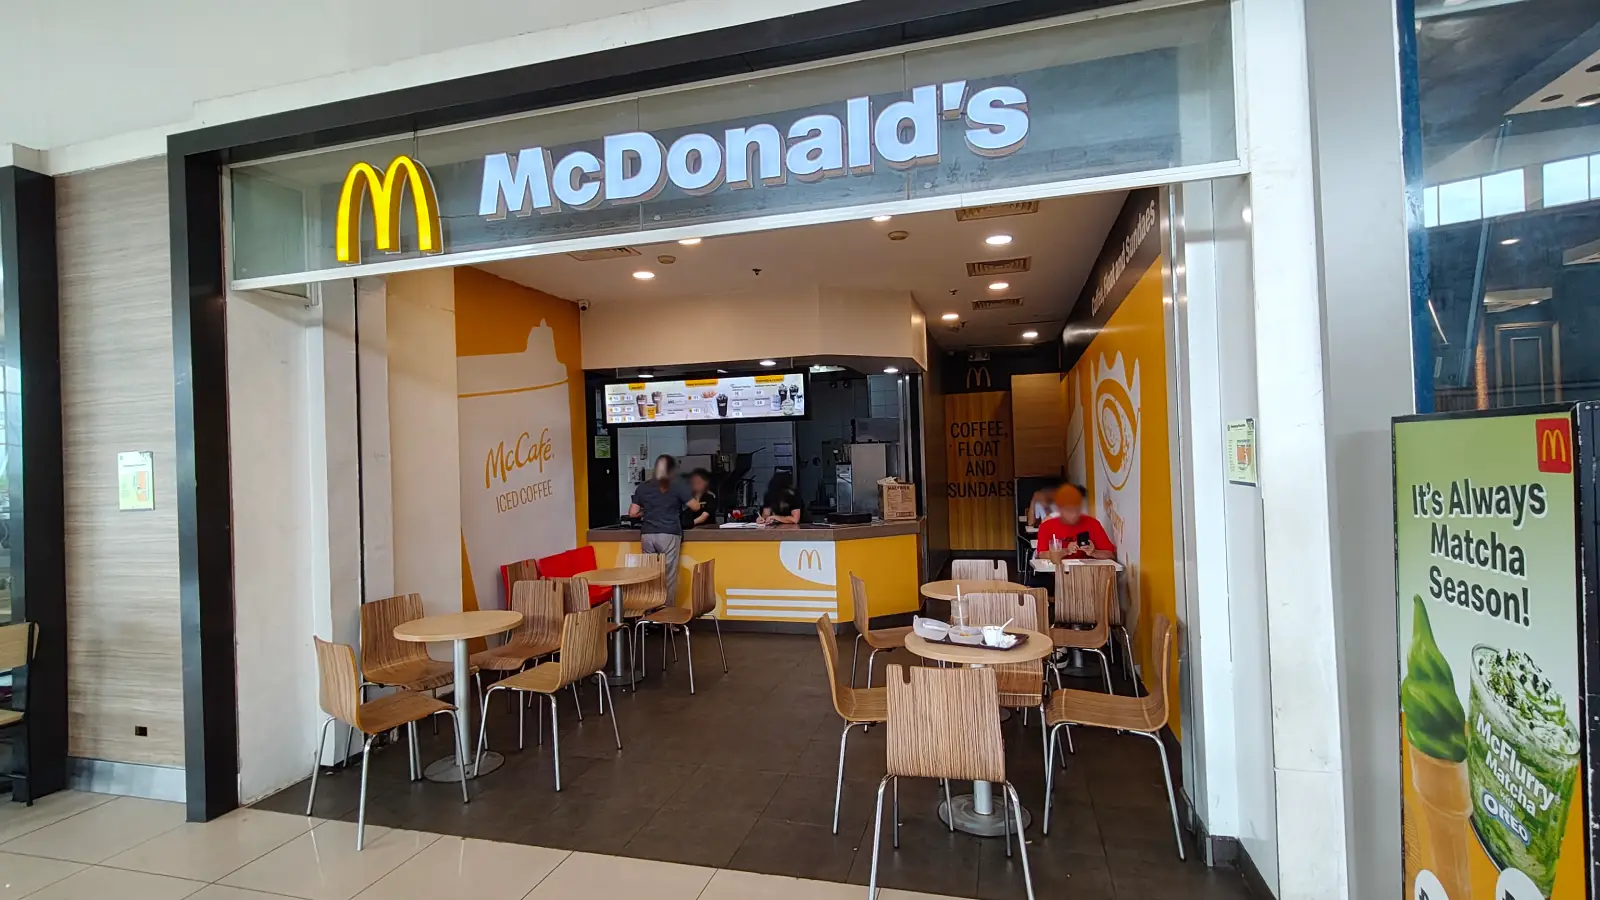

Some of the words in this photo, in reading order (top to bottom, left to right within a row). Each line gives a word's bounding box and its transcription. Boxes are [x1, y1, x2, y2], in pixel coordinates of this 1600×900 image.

[478, 79, 1031, 218] McDonald's
[1125, 199, 1156, 264] Sundaes
[950, 420, 1008, 439] COFFEE,
[958, 440, 1000, 457] FLOAT
[485, 427, 552, 490] McCafé
[965, 459, 996, 477] AND
[495, 490, 519, 514] ICED
[519, 479, 553, 505] COFFEE
[948, 480, 1015, 499] SUNDAES
[1411, 481, 1444, 517] It's
[1448, 478, 1547, 529] Always
[1430, 521, 1527, 578] Matcha
[1429, 564, 1531, 628] Season!
[1476, 711, 1555, 812] McFlurry
[1485, 749, 1536, 818] Matcha
[1483, 792, 1530, 843] OREO
[1500, 788, 1516, 812] with
